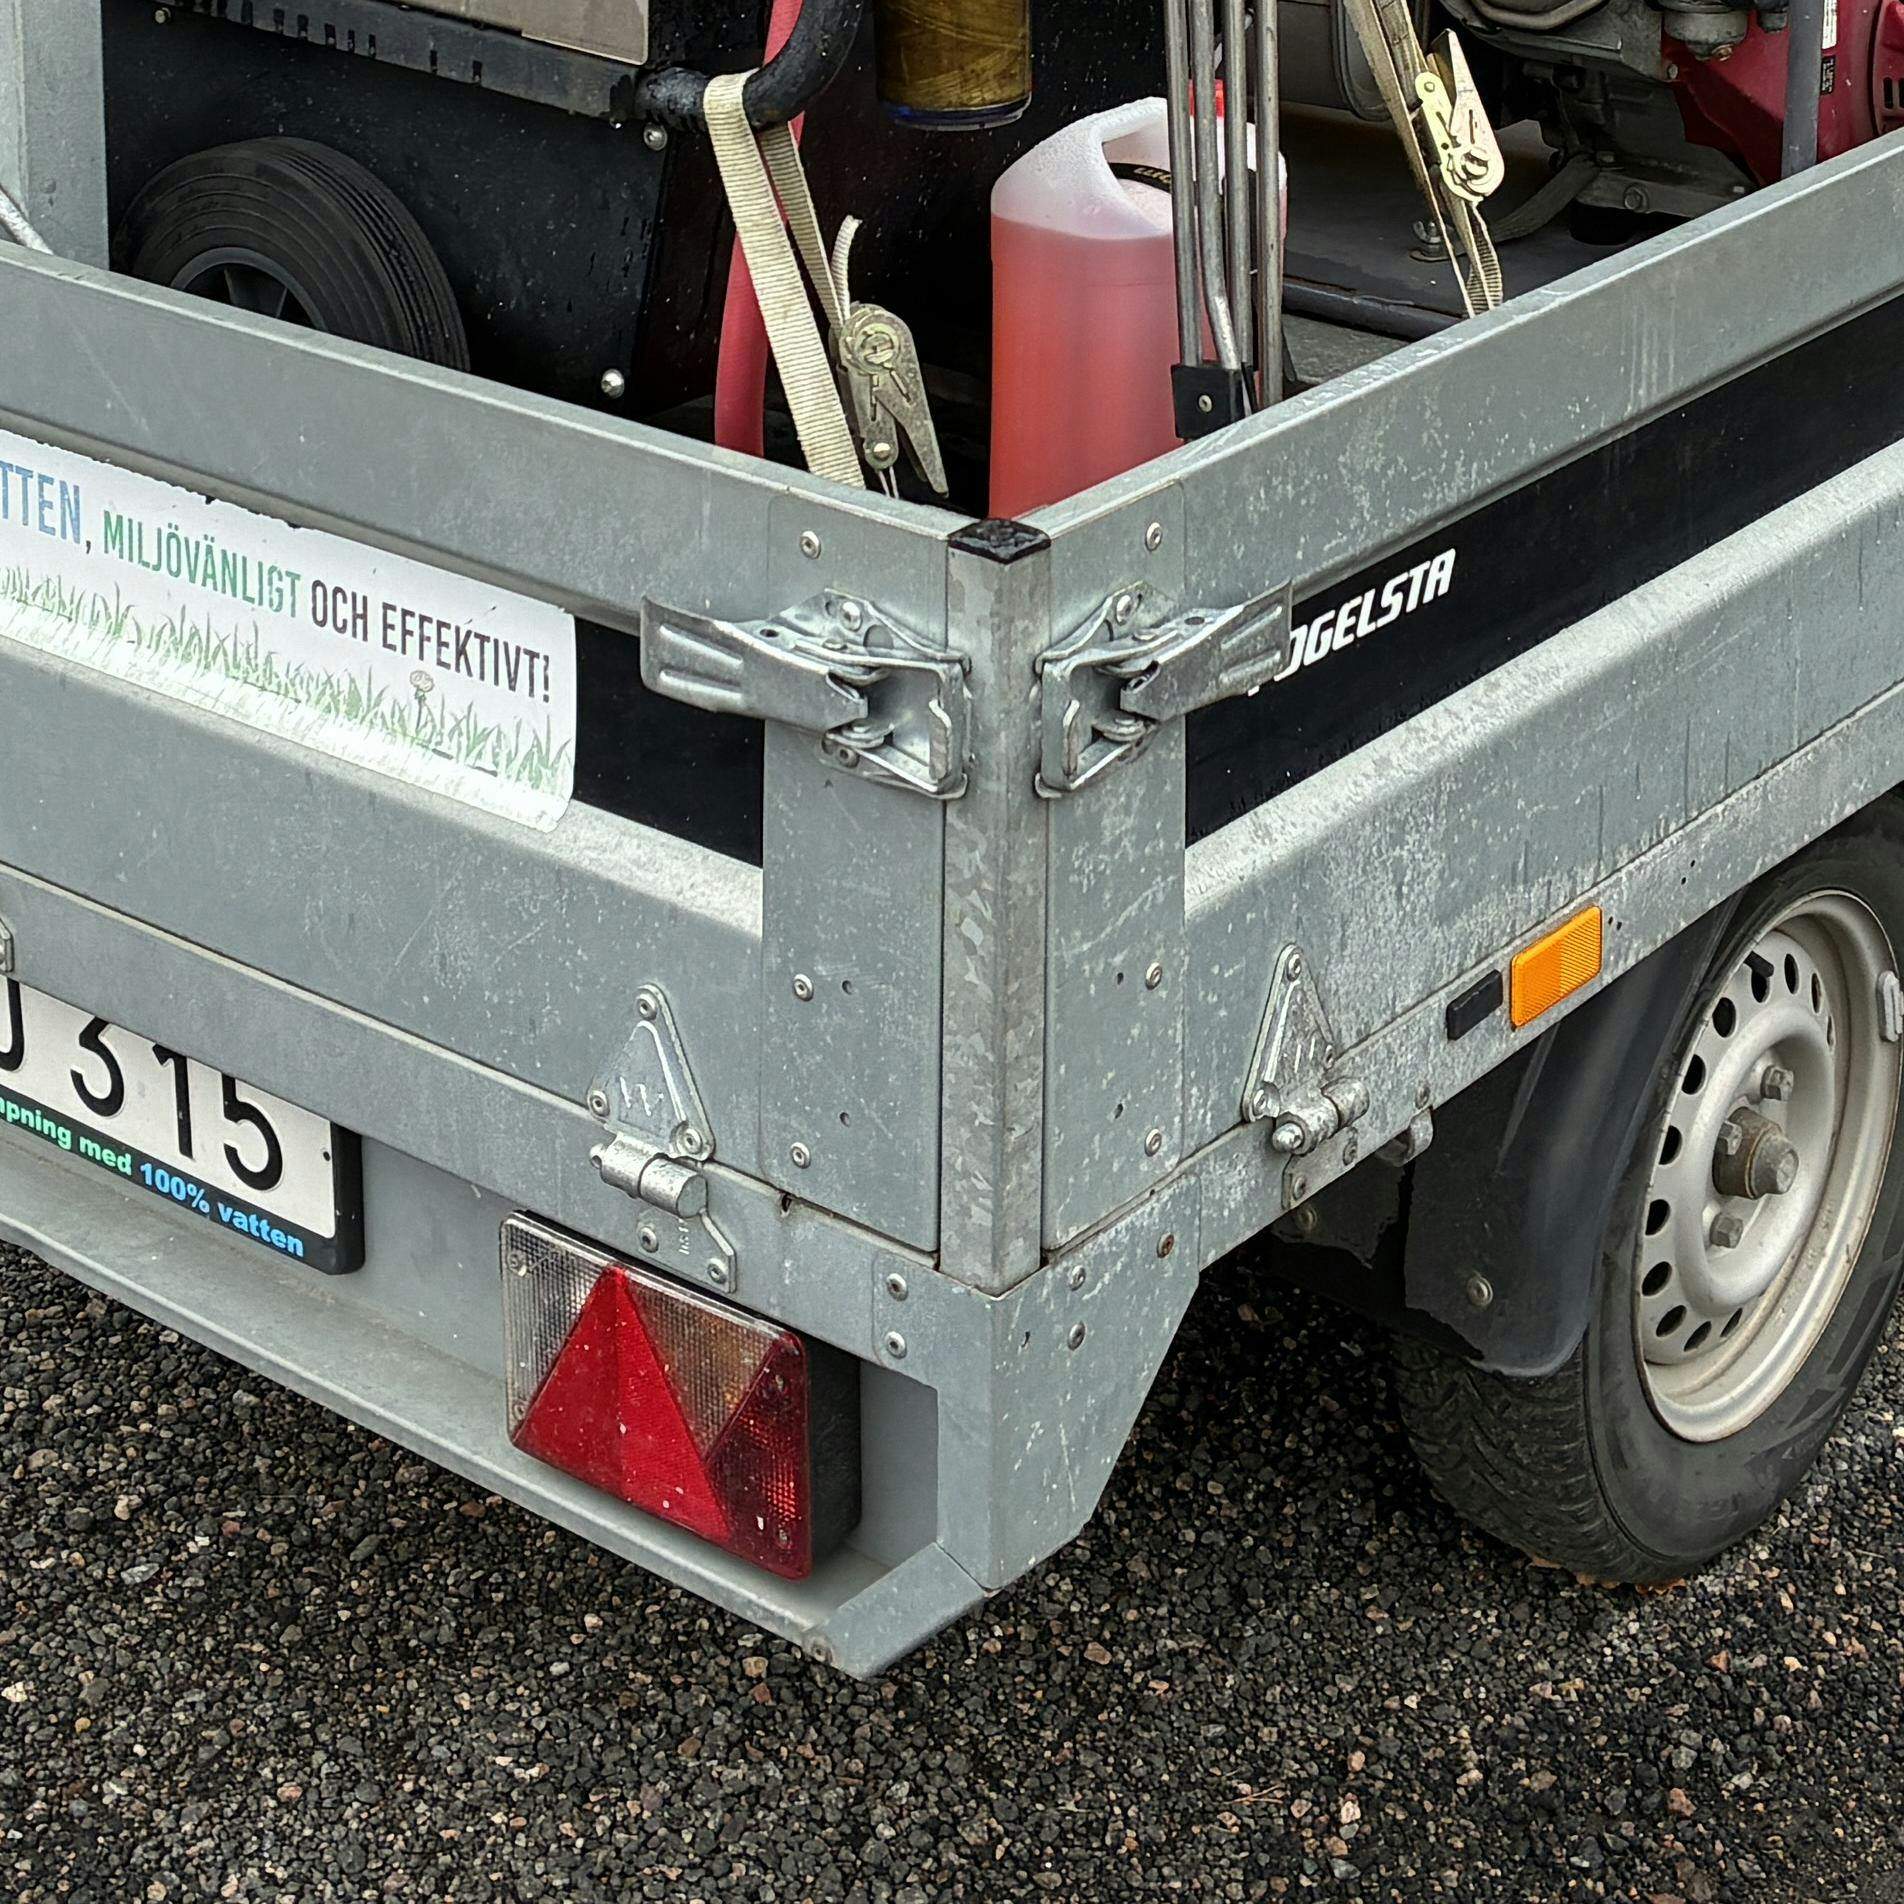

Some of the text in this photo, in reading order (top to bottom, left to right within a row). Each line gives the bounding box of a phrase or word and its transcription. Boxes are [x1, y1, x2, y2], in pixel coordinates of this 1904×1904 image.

[103, 509, 301, 619] MILJÖVÄNLIGT
[310, 579, 369, 643] OCH
[381, 601, 551, 704] EFFEKTIVT!
[1273, 548, 1457, 682] OGELSTA
[79, 1132, 132, 1176] med
[140, 1161, 210, 1214] 100%
[217, 1201, 305, 1258] vatten
